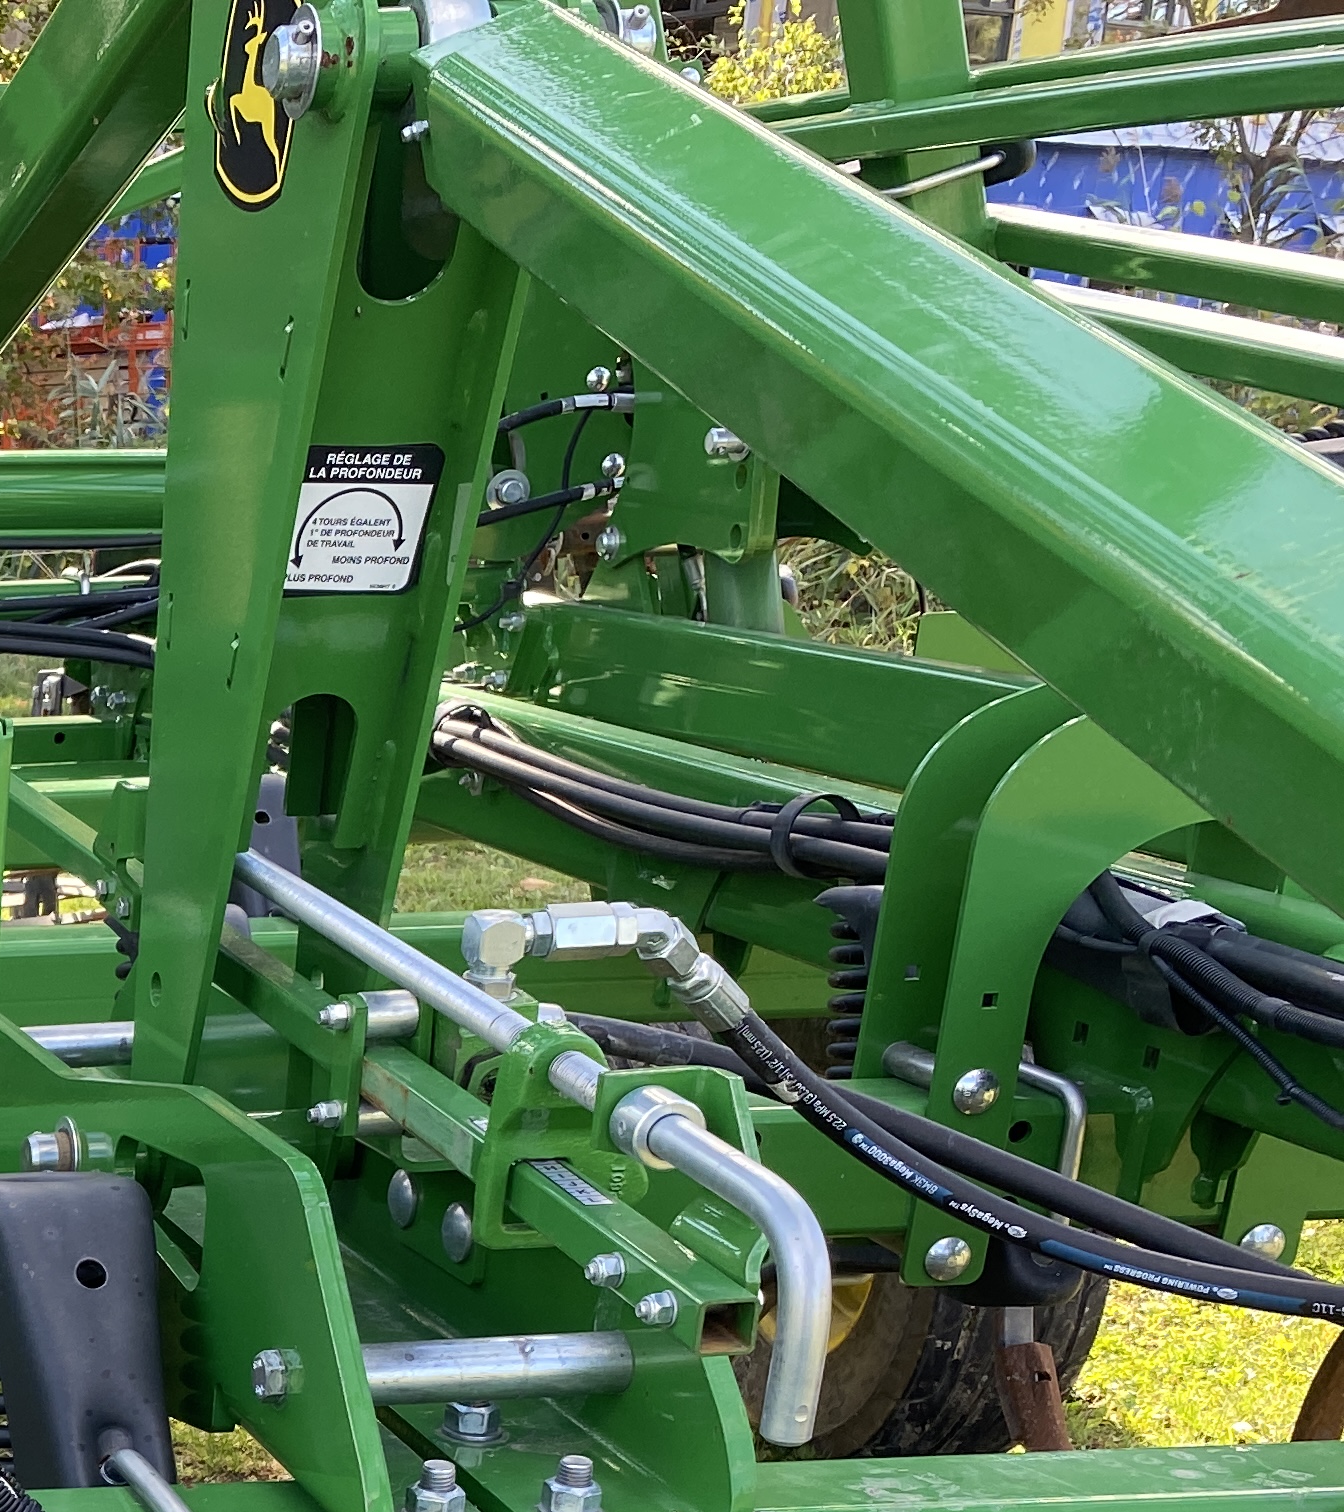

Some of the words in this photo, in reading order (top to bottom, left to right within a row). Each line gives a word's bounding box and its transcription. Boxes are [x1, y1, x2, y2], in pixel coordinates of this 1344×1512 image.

[326, 450, 391, 465] RÉGLAGE
[393, 454, 412, 466] DE
[309, 467, 326, 479] LA
[330, 467, 422, 480] PROFONDEUR
[319, 518, 348, 526] TOURS
[350, 516, 392, 526] ÉGALENT
[320, 529, 333, 537] DE
[334, 529, 395, 538] PROFONDEUR
[307, 540, 319, 548] DE
[320, 540, 354, 548] TRAVAIL
[332, 555, 362, 565] MOINS
[364, 556, 410, 565] PROFOND
[308, 573, 353, 583] PROFOND
[1162, 1277, 1211, 1294] POWERING
